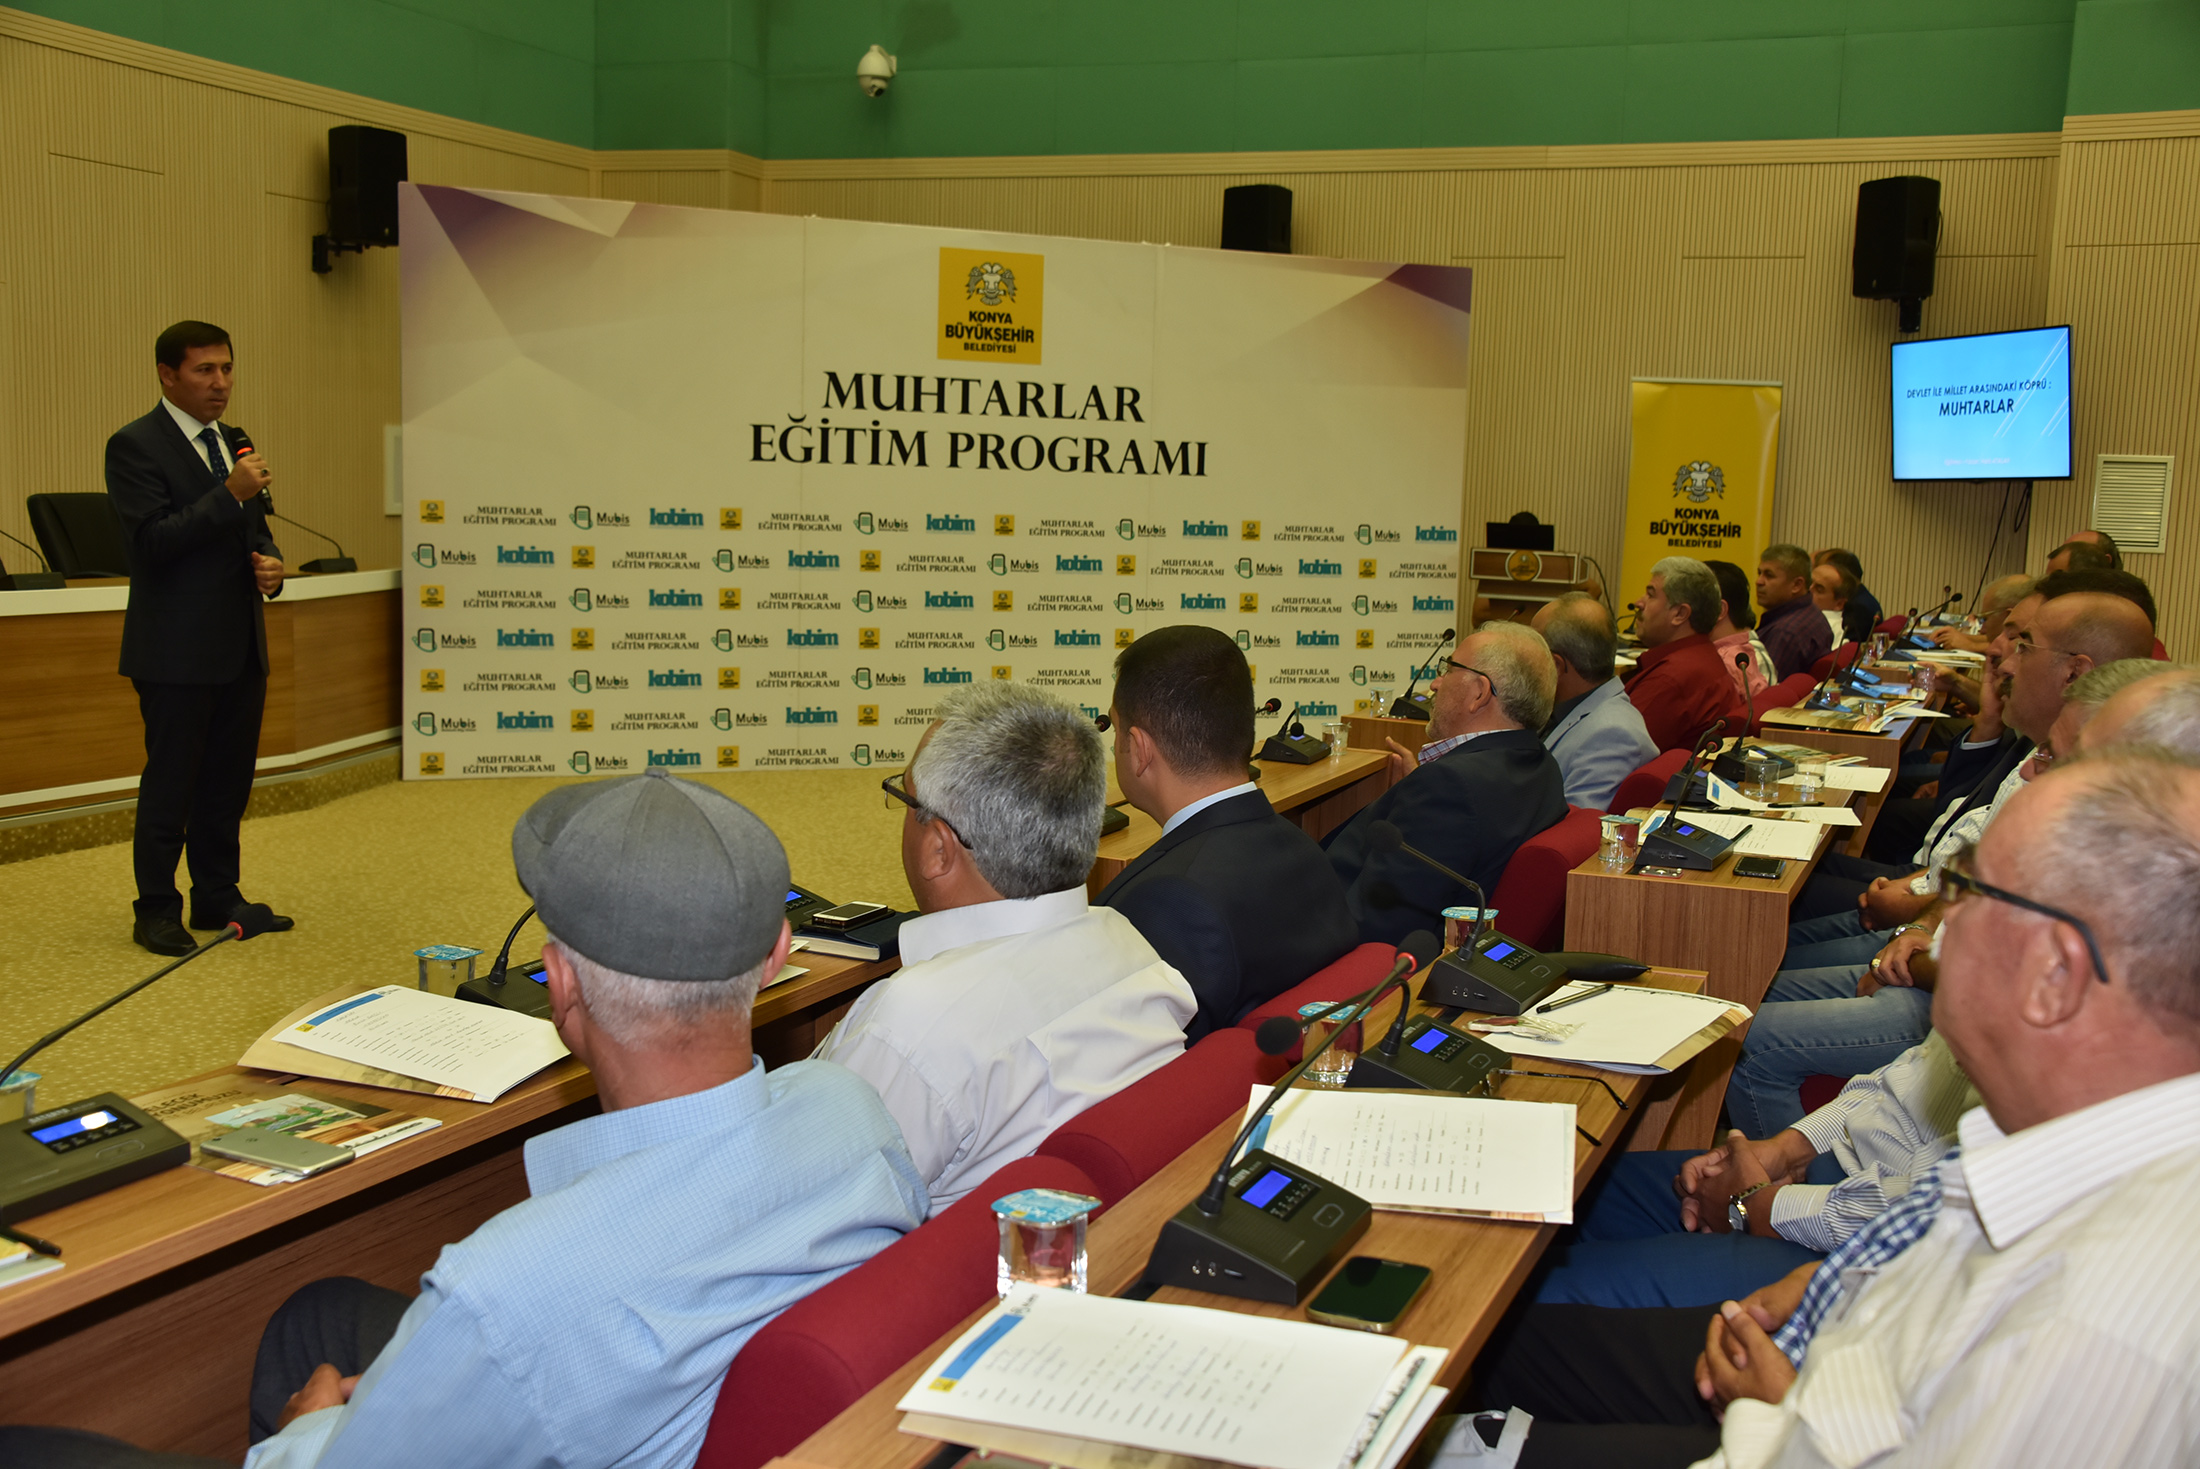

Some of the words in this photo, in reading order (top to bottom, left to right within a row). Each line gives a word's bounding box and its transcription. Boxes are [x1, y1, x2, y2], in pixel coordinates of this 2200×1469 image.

[968, 310, 1013, 324] KONYA
[945, 322, 1035, 343] BÜYÜKŞEHİR
[963, 342, 1017, 353] BELEDİYESİ
[1907, 388, 1931, 398] DEVLET
[1933, 386, 1942, 397] İLE
[1944, 385, 1967, 396] MİLLET
[1969, 380, 2017, 393] ARASINDAKİ
[2019, 377, 2047, 390] KÖPRÜ
[821, 371, 1145, 423] MUHTARLAR
[1939, 399, 2014, 416] MUHTARLAR
[749, 412, 929, 467] EĞİTİM
[947, 431, 1209, 477] PROGRAMI
[477, 506, 543, 516] MUHTARLAR
[1674, 508, 1720, 520] KONYA
[463, 516, 499, 525] EĞİTİM
[501, 516, 557, 526] PROGRAMI
[597, 512, 630, 523] Mubis
[650, 508, 704, 526] kobim
[771, 513, 830, 522] MUHTARLAR
[926, 514, 975, 531] kobim
[758, 521, 790, 531] EĞİTİM
[792, 522, 842, 532] PROGRAMI
[878, 518, 908, 529] Mubis
[1041, 519, 1094, 528] MUHTARLAR
[1183, 520, 1228, 537] kobim
[1285, 525, 1334, 533] MUHTARLAR
[1650, 519, 1742, 538] BÜYÜKŞEHİR
[1029, 527, 1058, 537] EĞİTİM
[1060, 528, 1105, 537] PROGRAMI
[1138, 524, 1166, 535] Mubis
[1375, 529, 1400, 540] Mubis
[1415, 525, 1457, 541] kobim
[1274, 533, 1301, 542] EĞİTİM
[1303, 534, 1344, 542] PROGRAMI
[1668, 539, 1722, 548] BELEDİYESİ
[441, 550, 476, 562] Mubis
[497, 546, 554, 564] kobim
[625, 551, 687, 560] MUHTARLAR
[738, 555, 769, 566] Mubis
[788, 550, 839, 567] kobim
[908, 555, 964, 563] MUHTARLAR
[612, 559, 645, 569] EĞİTİM
[648, 560, 700, 569] PROGRAMI
[896, 563, 927, 572] EĞİTİM
[929, 564, 976, 572] PROGRAMI
[1011, 559, 1039, 570] Mubis
[1056, 554, 1102, 571] kobim
[1162, 559, 1213, 567] MUHTARLAR
[1256, 562, 1282, 574] Mubis
[1298, 558, 1342, 574] kobim
[1150, 567, 1179, 576] EĞİTİM
[1181, 567, 1225, 576] PROGRAMI
[477, 590, 542, 599] MUHTARLAR
[596, 594, 629, 606] Mubis
[649, 589, 702, 607] kobim
[769, 592, 828, 600] MUHTARLAR
[925, 591, 974, 608] kobim
[463, 599, 498, 608] EĞİTİM
[501, 600, 556, 609] PROGRAMI
[757, 600, 789, 610] EĞİTİM
[792, 601, 841, 610] PROGRAMI
[877, 596, 907, 607] Mubis
[1027, 602, 1056, 611] EĞİTİM
[1058, 603, 1103, 611] PROGRAMI
[1136, 598, 1164, 608] Mubis
[1181, 593, 1226, 609] kobim
[1282, 597, 1331, 605] MUHTARLAR
[1372, 600, 1398, 610] Mubis
[1412, 596, 1454, 611] kobim
[1271, 604, 1298, 612] EĞİTİM
[1300, 605, 1342, 613] PROGRAMI
[441, 634, 476, 646] Mubis
[497, 629, 554, 647] kobim
[625, 632, 686, 641] MUHTARLAR
[737, 634, 768, 646] Mubis
[787, 629, 838, 647] kobim
[907, 632, 963, 640] MUHTARLAR
[1009, 634, 1037, 645] Mubis
[1054, 629, 1101, 646] kobim
[1254, 634, 1281, 645] Mubis
[1296, 630, 1339, 646] kobim
[612, 640, 645, 650] EĞİTİM
[647, 640, 699, 650] PROGRAMI
[895, 640, 925, 648] EĞİTİM
[928, 640, 975, 649] PROGRAMI
[477, 673, 542, 682] MUHTARLAR
[768, 671, 828, 679] MUHTARLAR
[924, 667, 972, 684] kobim
[1037, 669, 1091, 677] MUHTARLAR
[1280, 668, 1329, 676] MUHTARLAR
[1370, 671, 1395, 681] Mubis
[595, 675, 628, 687] Mubis
[648, 669, 702, 687] kobim
[756, 679, 788, 688] EĞİTİM
[790, 679, 840, 688] PROGRAMI
[876, 673, 906, 685] Mubis
[1057, 677, 1102, 686] PROGRAMI
[1269, 675, 1296, 684] EĞİTİM
[1298, 676, 1340, 684] PROGRAMI
[463, 682, 498, 692] EĞİTİM
[501, 682, 556, 691] PROGRAMI
[497, 711, 553, 730] kobim
[624, 713, 686, 721] MUHTARLAR
[736, 713, 767, 725] Mubis
[786, 707, 838, 725] kobim
[894, 716, 925, 726] EĞİTİM
[441, 718, 476, 730] Mubis
[611, 722, 645, 731] EĞİTİM
[647, 721, 699, 731] PROGRAMI
[648, 749, 702, 767] kobim
[768, 749, 827, 757] MUHTARLAR
[875, 749, 905, 761] Mubis
[477, 755, 542, 764] MUHTARLAR
[595, 756, 628, 768] Mubis
[755, 757, 787, 766] EĞİTİM
[790, 757, 839, 766] PROGRAMI
[463, 764, 498, 774] EĞİTİM
[501, 764, 556, 774] PROGRAMI
